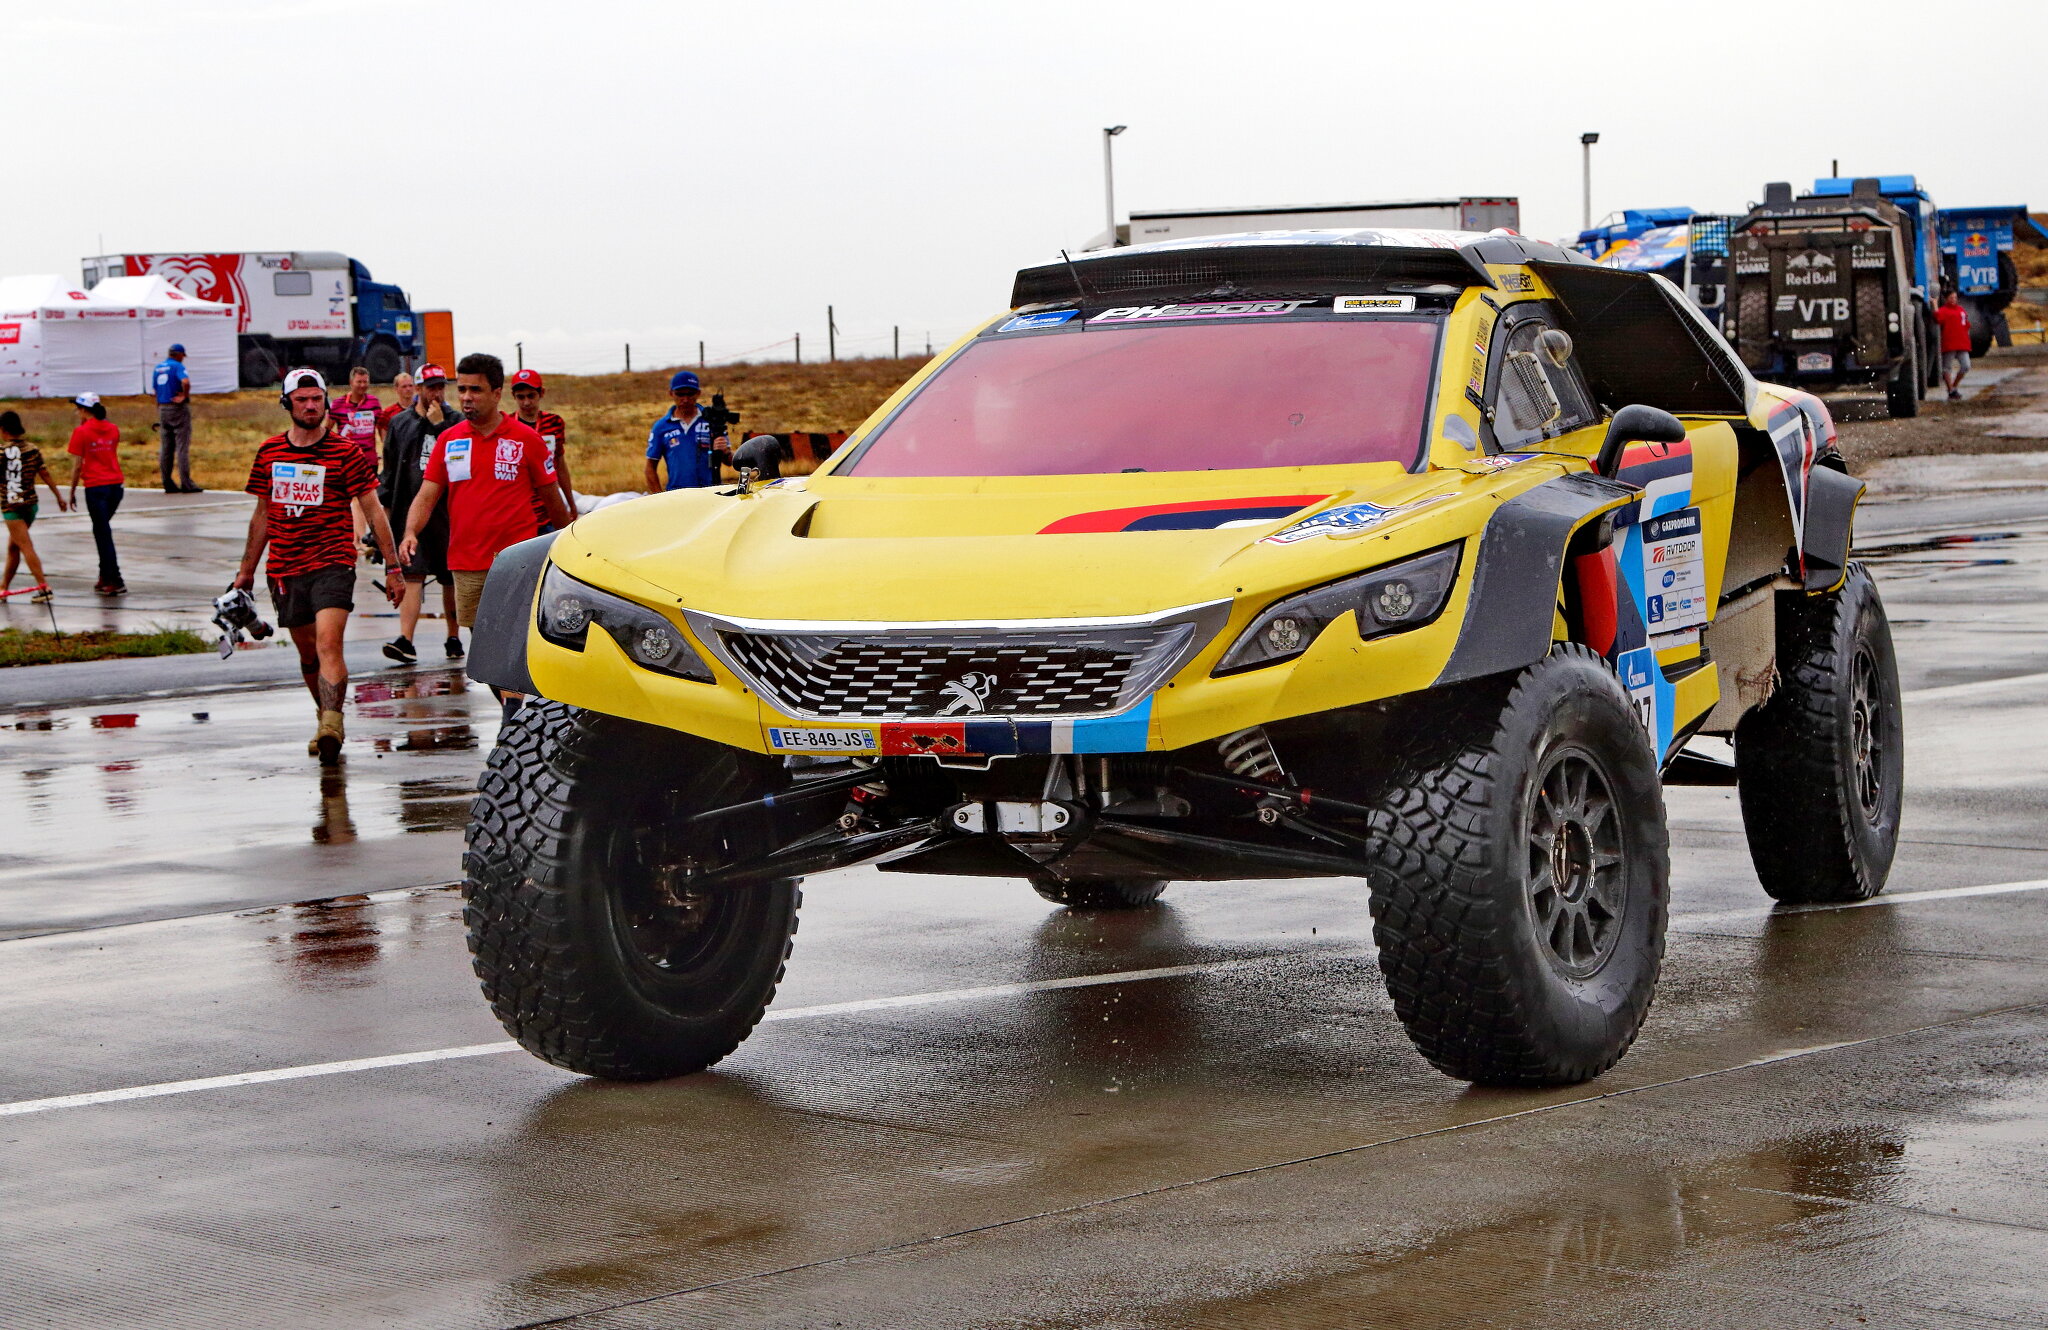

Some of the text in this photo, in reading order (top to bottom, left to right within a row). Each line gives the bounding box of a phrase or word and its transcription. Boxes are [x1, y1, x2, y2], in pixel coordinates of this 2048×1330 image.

[1736, 262, 1770, 274] KAMAZ
[1970, 266, 1998, 284] VTB
[1786, 270, 1837, 286] Red Bull
[1798, 297, 1850, 322] VTB
[5, 446, 24, 504] PRESS
[494, 462, 518, 474] SILK
[494, 471, 518, 482] WAY
[292, 482, 320, 493] SILK
[292, 492, 320, 503] WAY
[284, 504, 305, 518] TV
[1661, 516, 1696, 532] GAZPROMBANK
[782, 731, 863, 747] EE-849-JS
